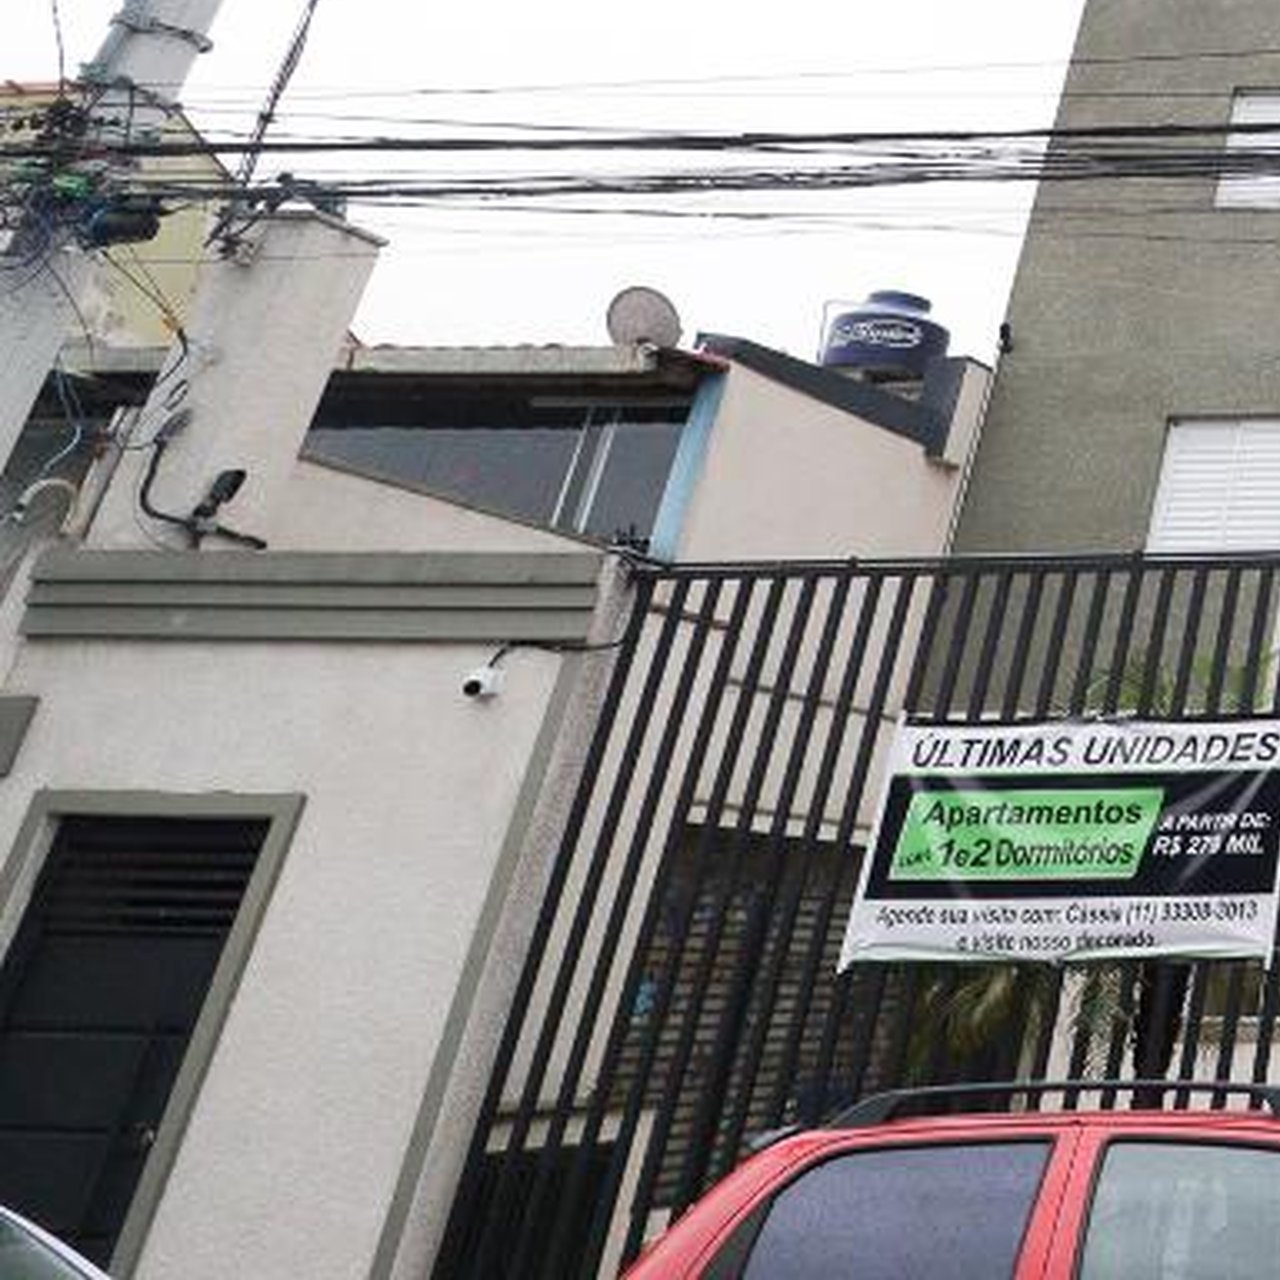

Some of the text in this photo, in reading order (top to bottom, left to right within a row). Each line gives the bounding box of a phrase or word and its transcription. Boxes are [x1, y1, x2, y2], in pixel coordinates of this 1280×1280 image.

[911, 732, 1280, 769] ÚLTIMAS UNIDADES
[923, 799, 1142, 833] Apartamentos
[996, 836, 1135, 867] Dormitórios
[1152, 835, 1182, 858] R$
[1019, 935, 1071, 952] nosso
